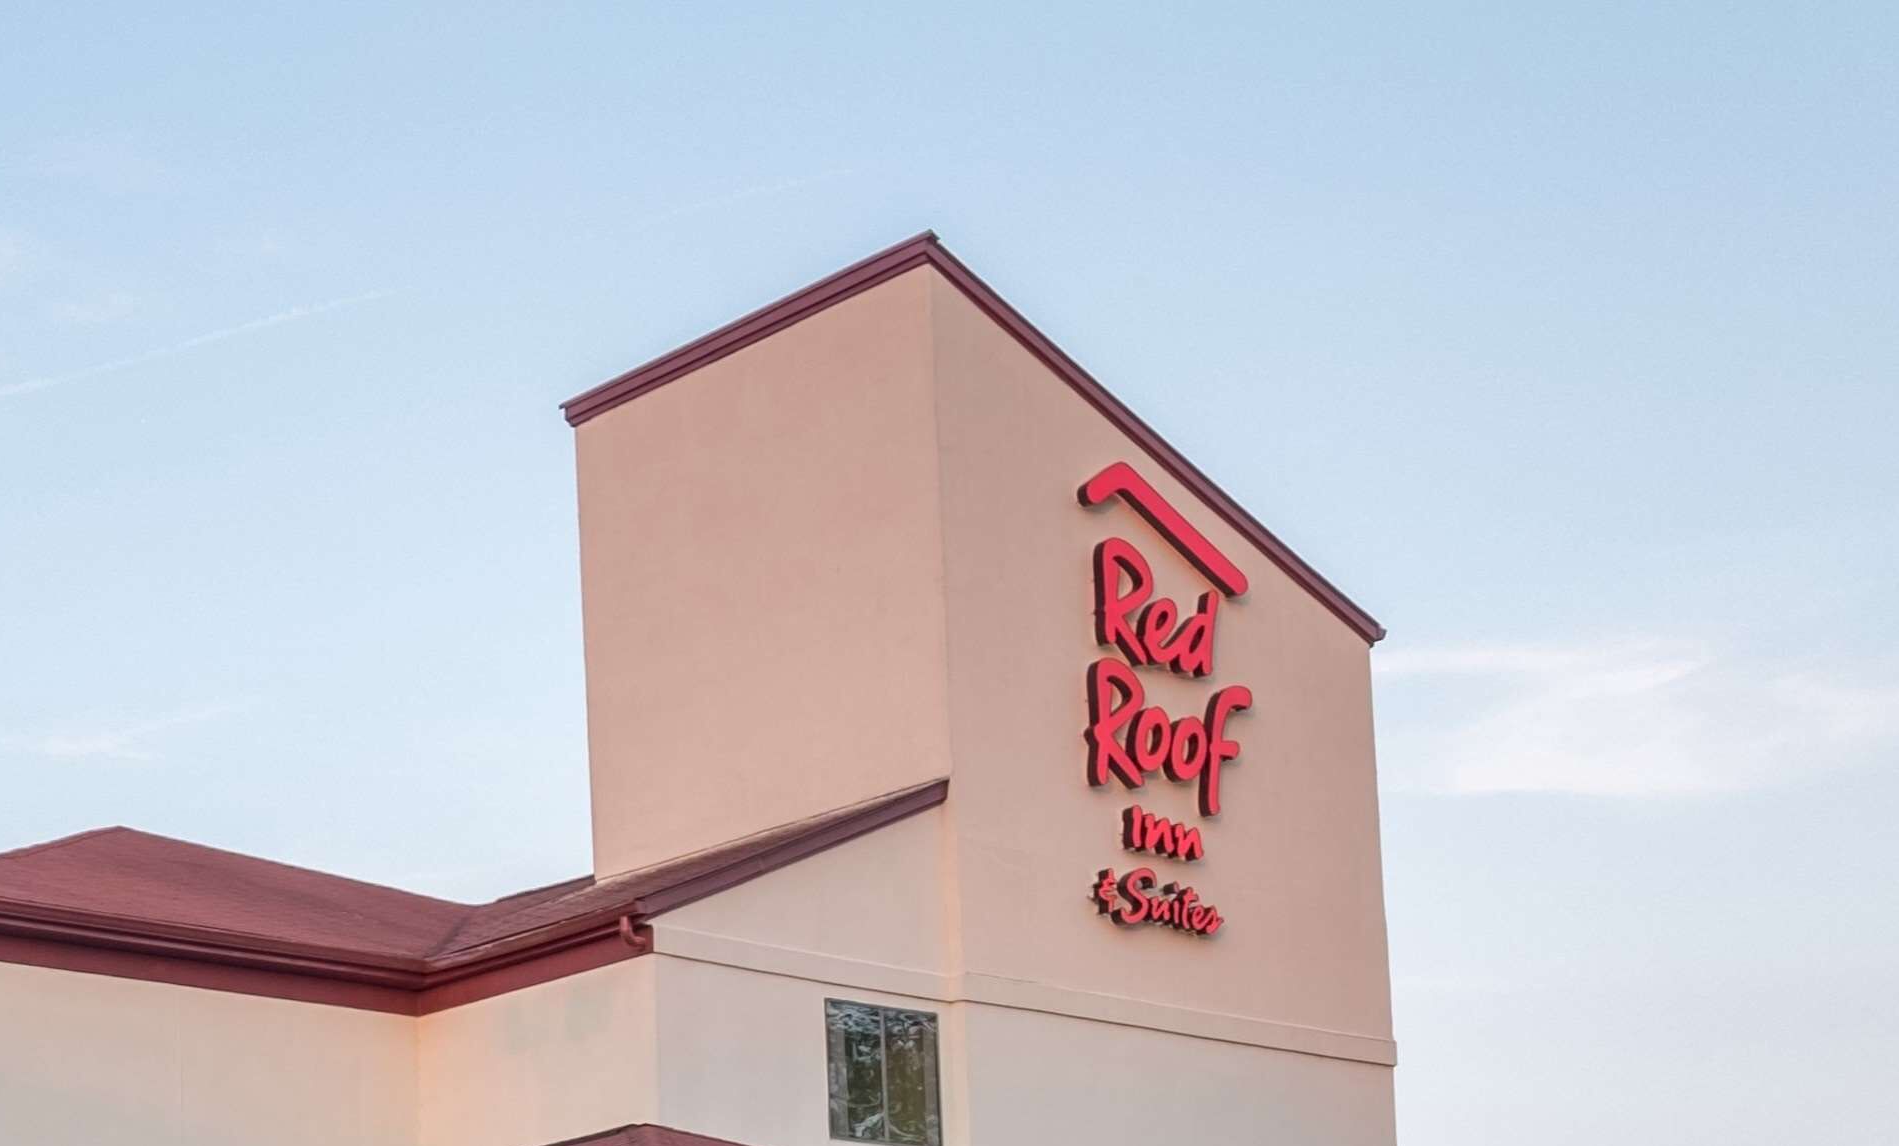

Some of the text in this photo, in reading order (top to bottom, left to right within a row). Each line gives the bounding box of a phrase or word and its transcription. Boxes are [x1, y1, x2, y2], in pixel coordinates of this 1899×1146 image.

[1092, 537, 1219, 677] Red
[1084, 657, 1253, 817] Roof
[1122, 805, 1204, 861] Inn
